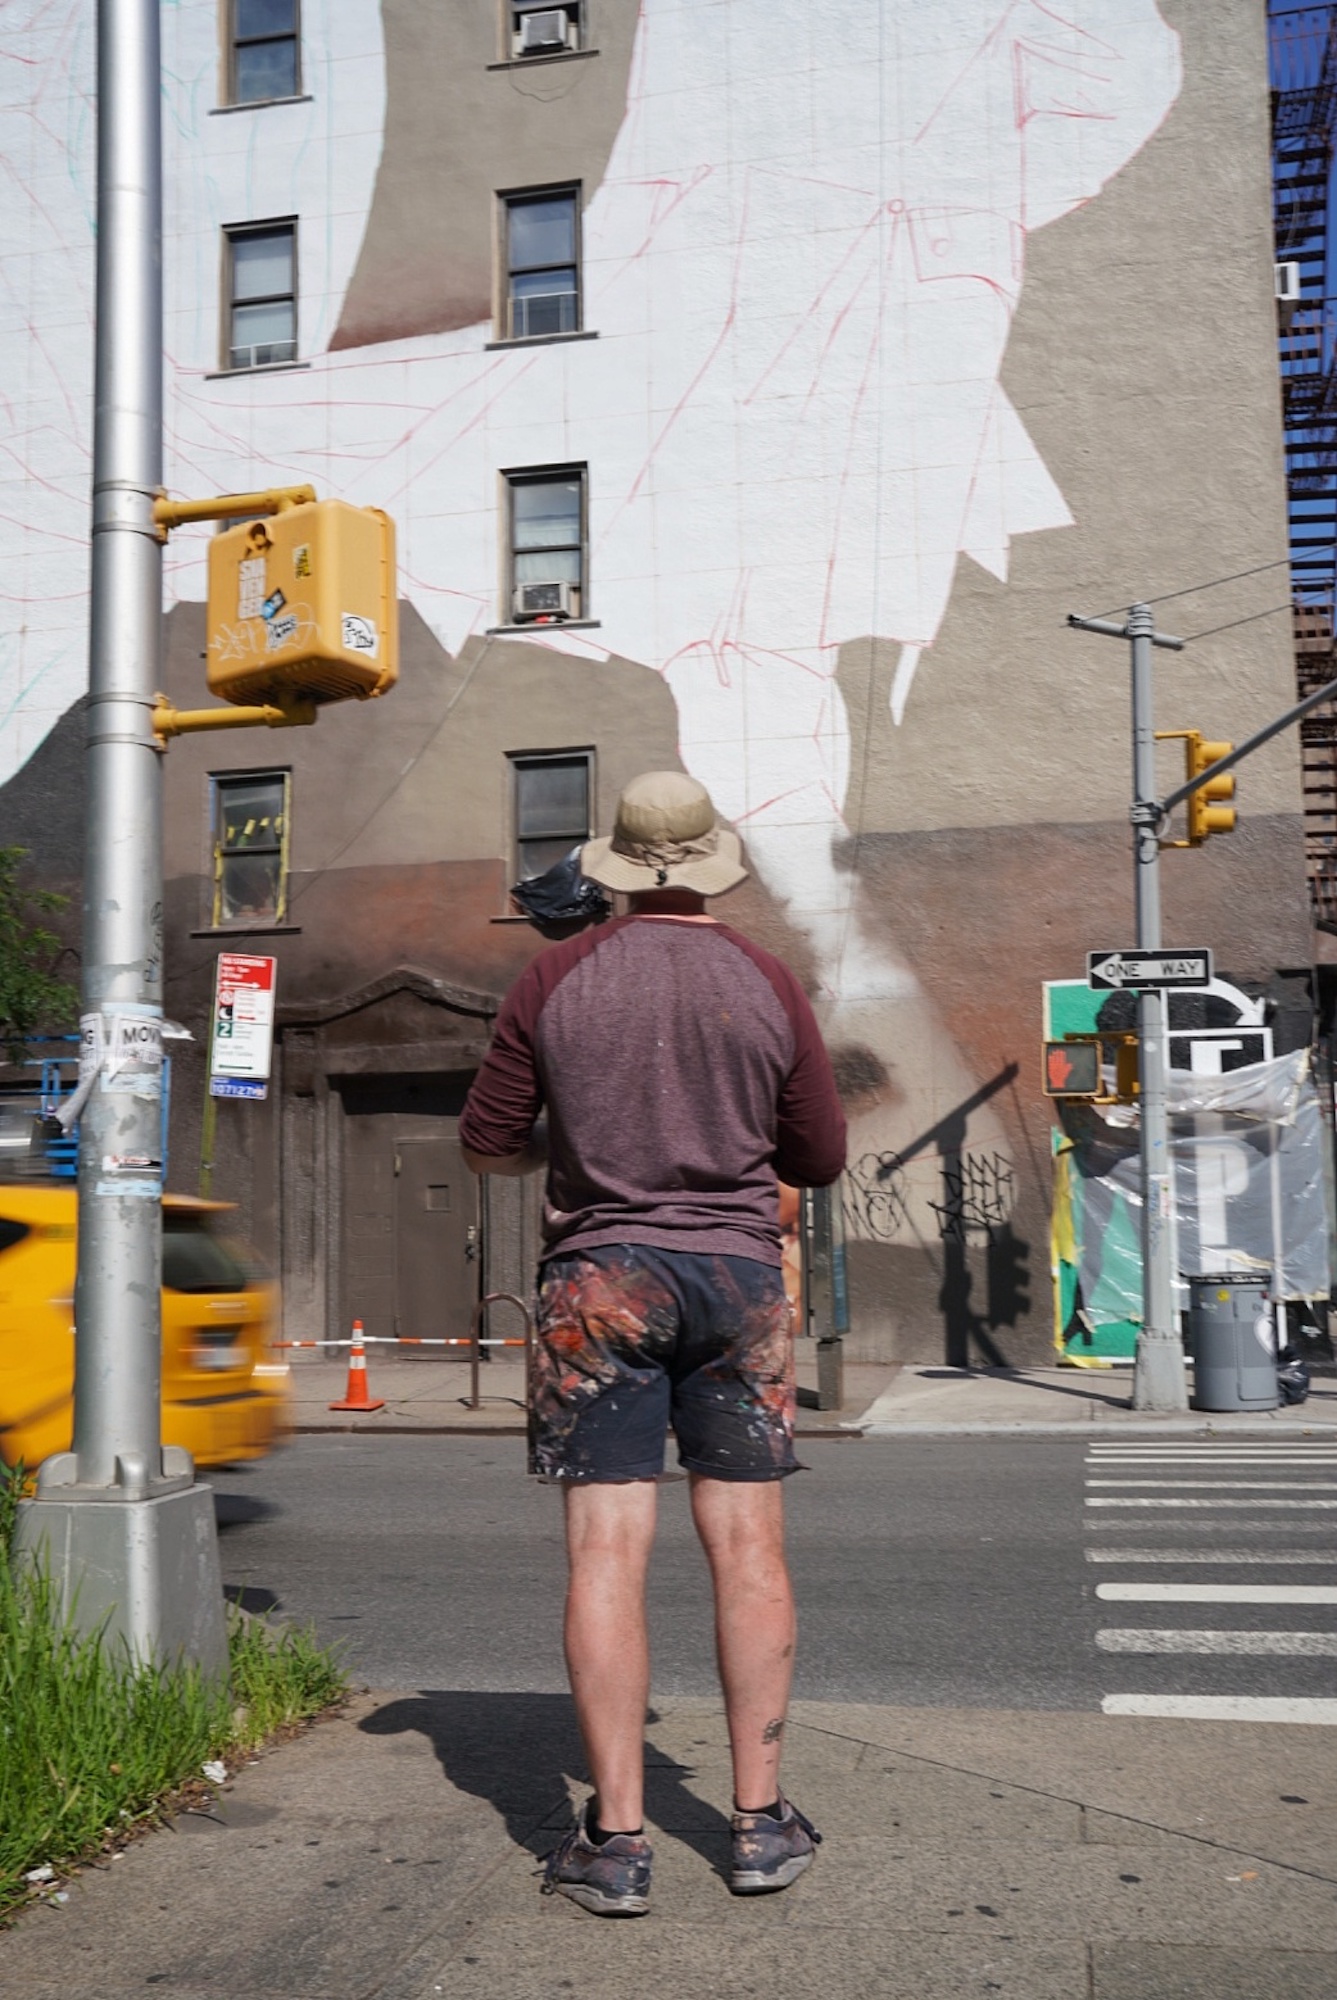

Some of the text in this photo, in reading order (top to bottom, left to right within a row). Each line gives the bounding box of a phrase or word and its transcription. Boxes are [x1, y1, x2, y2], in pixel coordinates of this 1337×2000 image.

[1104, 960, 1201, 978] ONE WAY
[219, 1021, 232, 1037] 2
